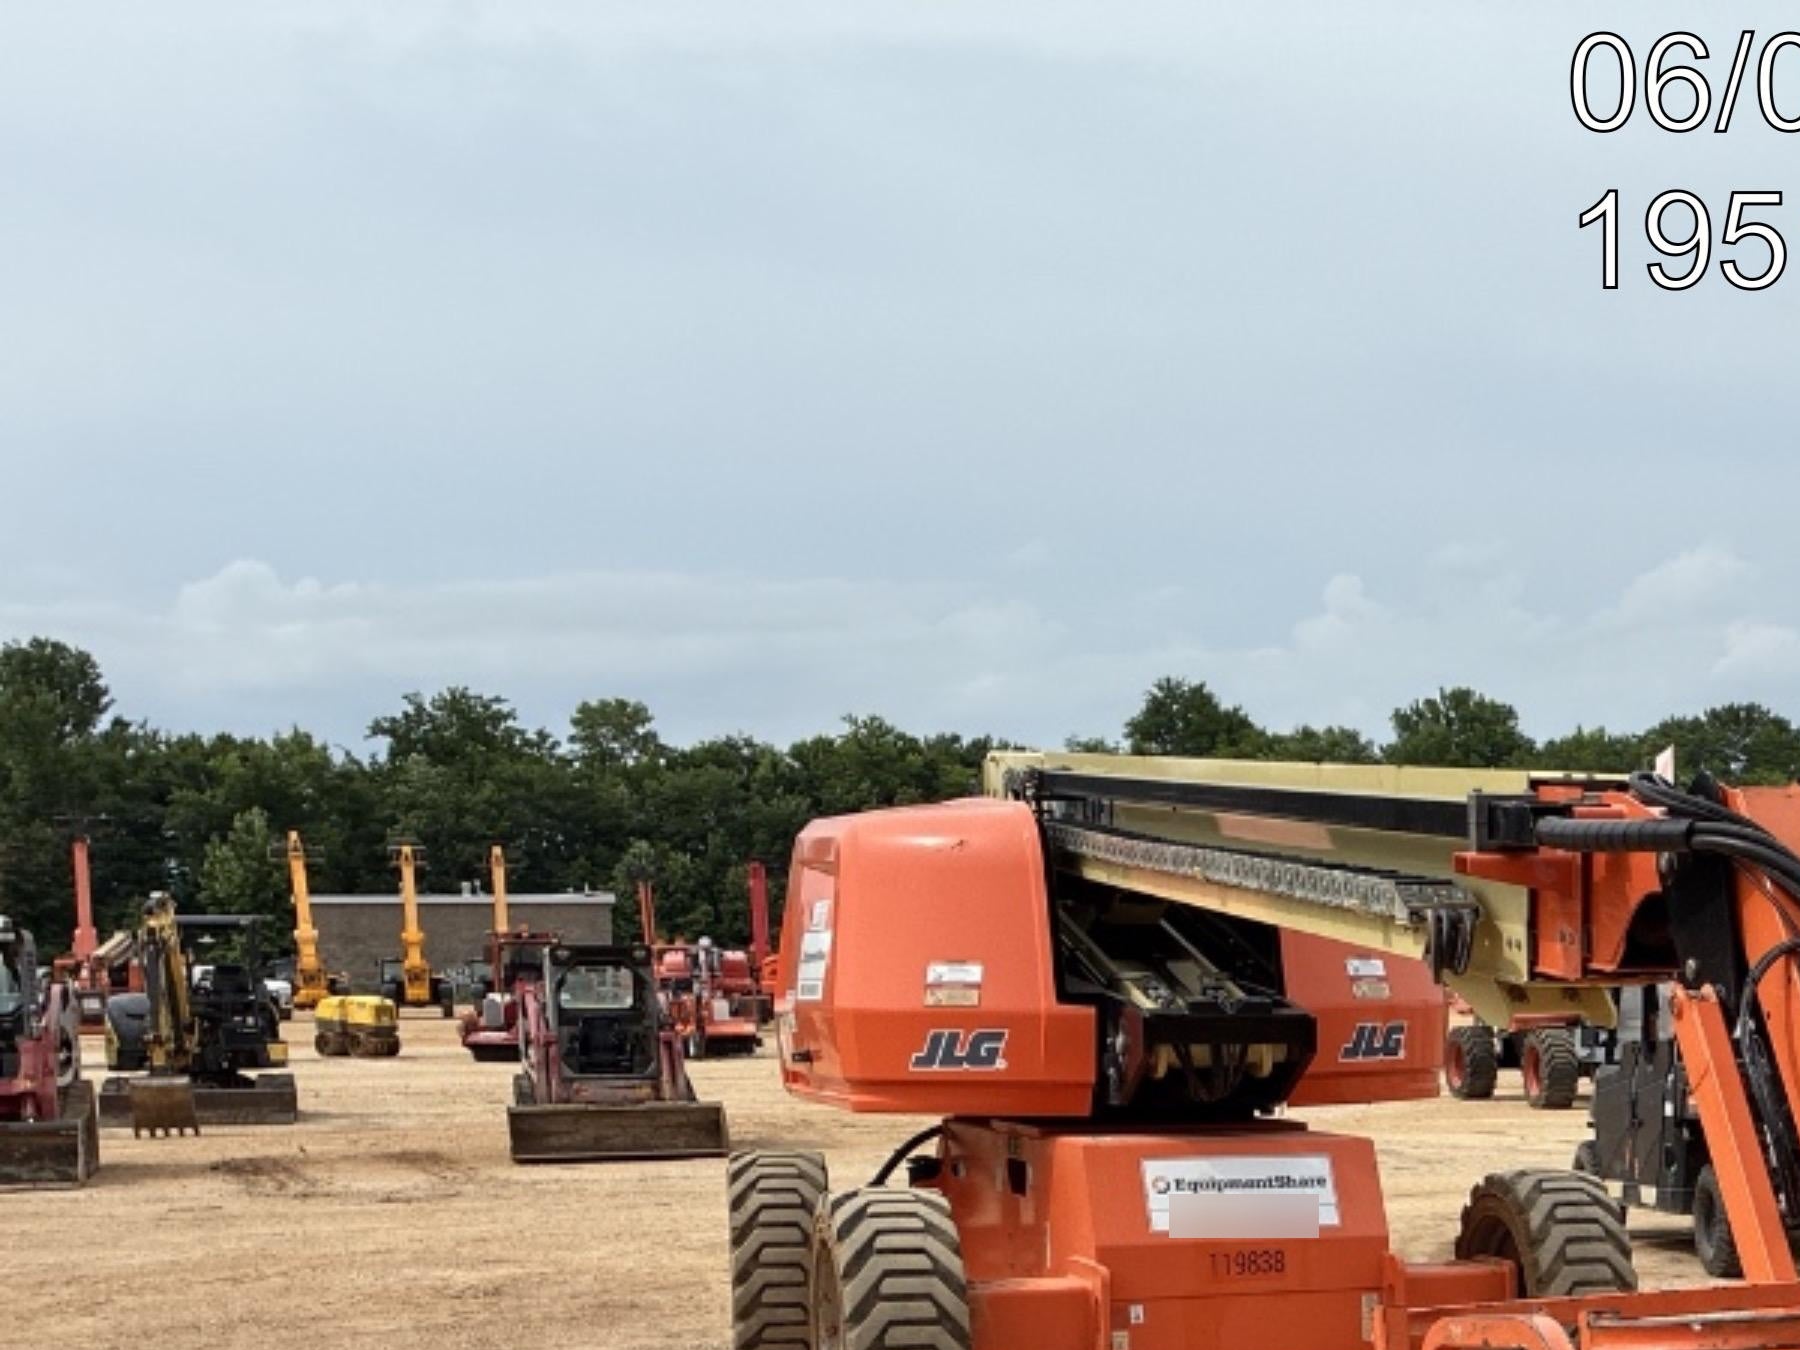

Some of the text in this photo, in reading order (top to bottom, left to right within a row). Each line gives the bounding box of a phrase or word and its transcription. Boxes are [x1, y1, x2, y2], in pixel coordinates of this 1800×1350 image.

[908, 1028, 1008, 1071] JLG
[1338, 1020, 1407, 1062] JLG
[1174, 1174, 1327, 1194] EquipmentShare
[1209, 1250, 1285, 1277] 119838
